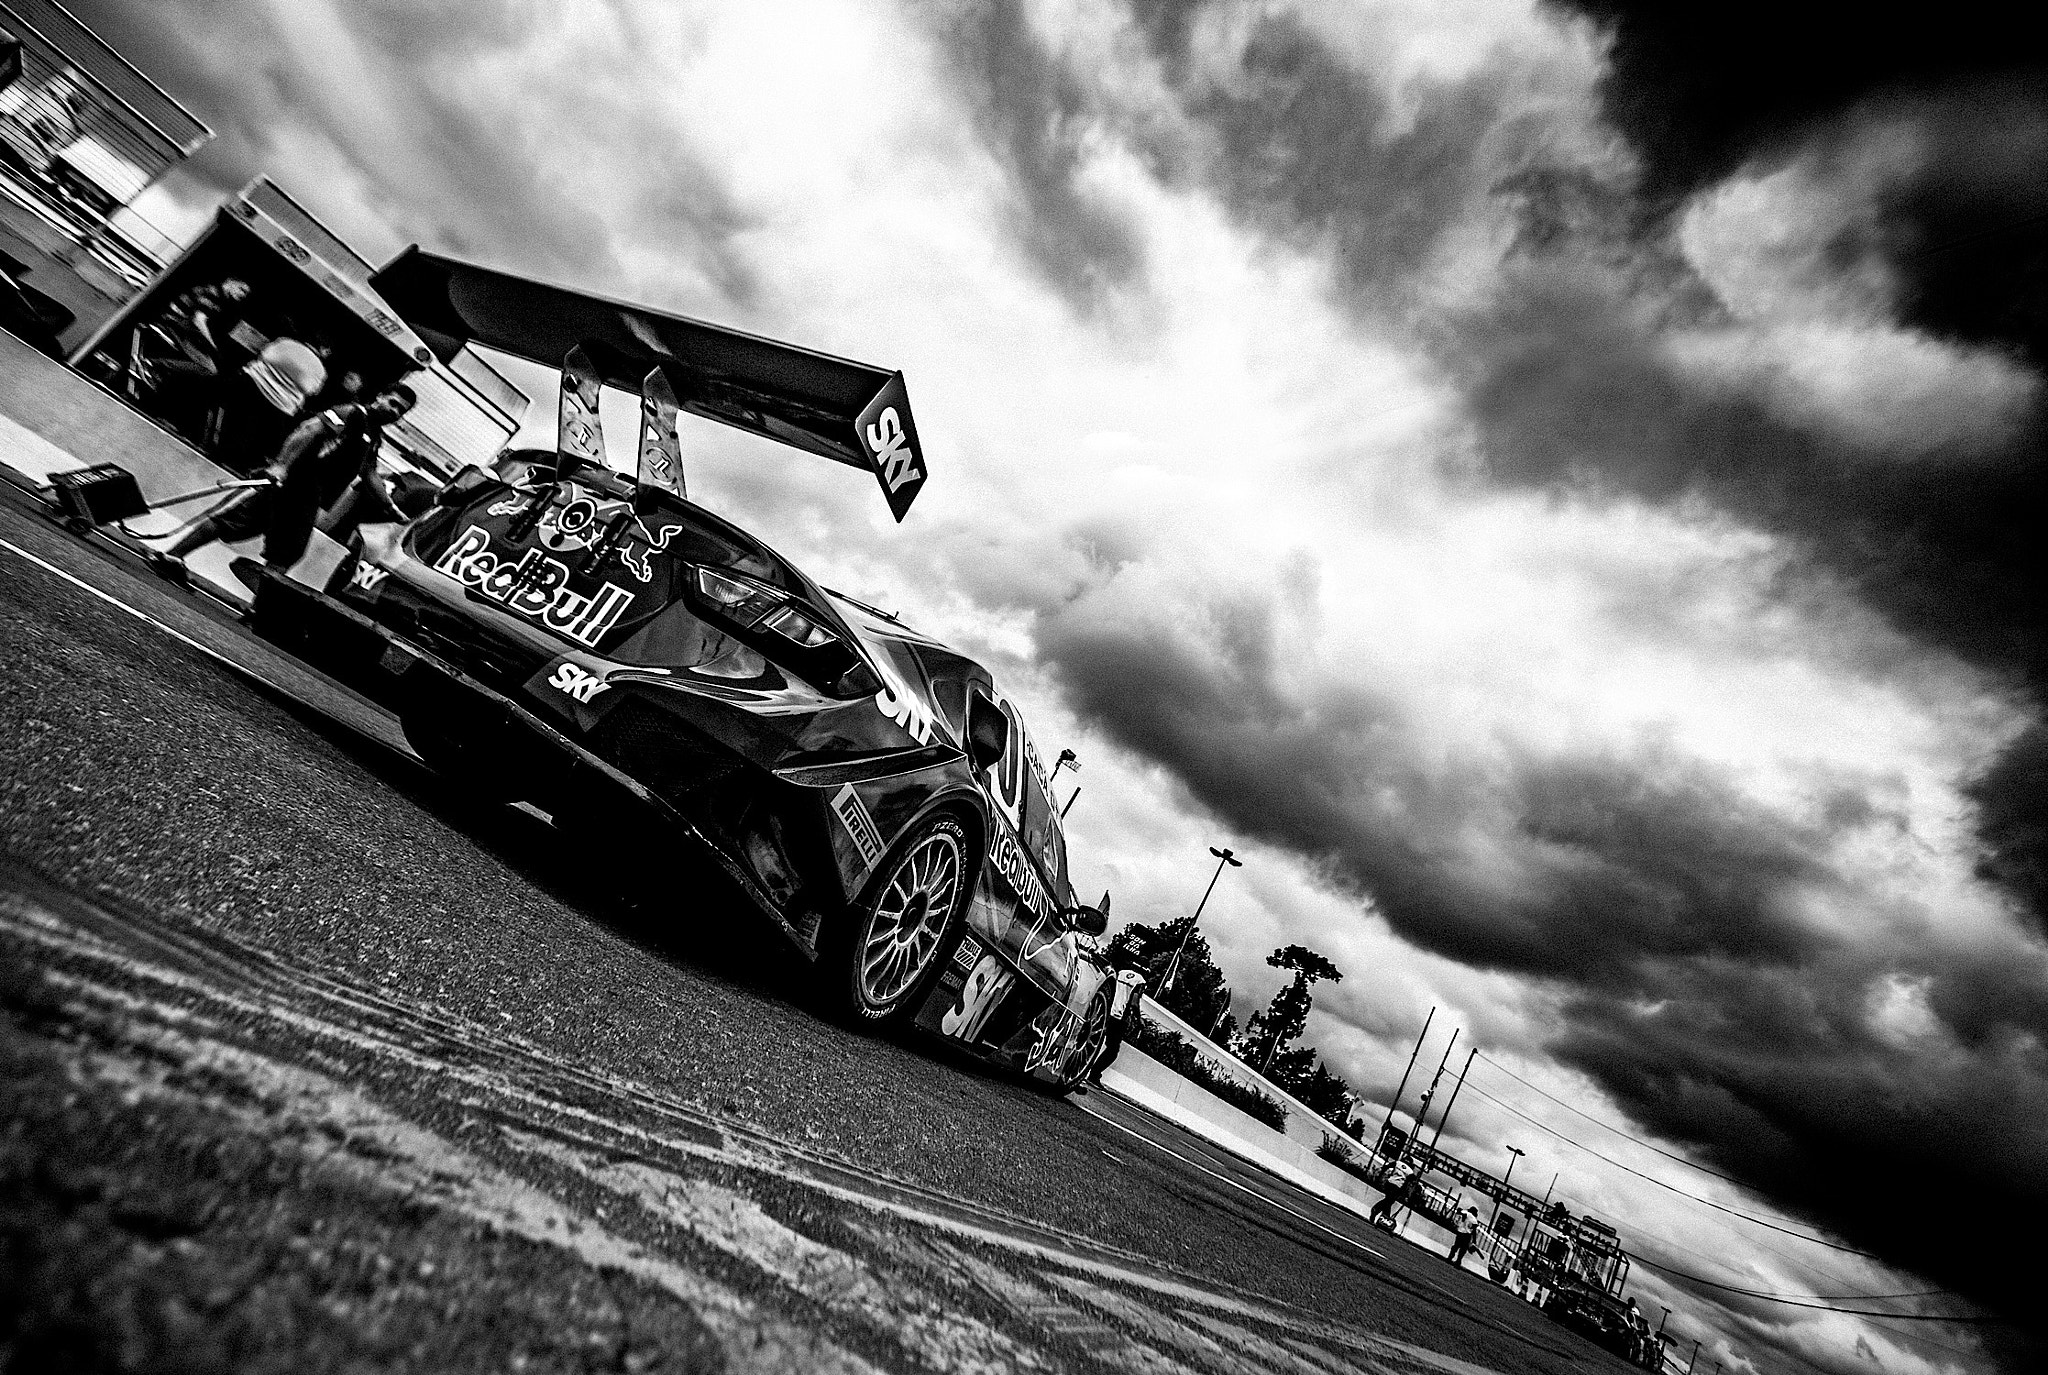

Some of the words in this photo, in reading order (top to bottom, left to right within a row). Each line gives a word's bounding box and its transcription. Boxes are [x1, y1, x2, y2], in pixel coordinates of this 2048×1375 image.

[866, 406, 921, 494] SKY
[548, 662, 612, 704] SKY
[838, 792, 883, 863] PIRELLI
